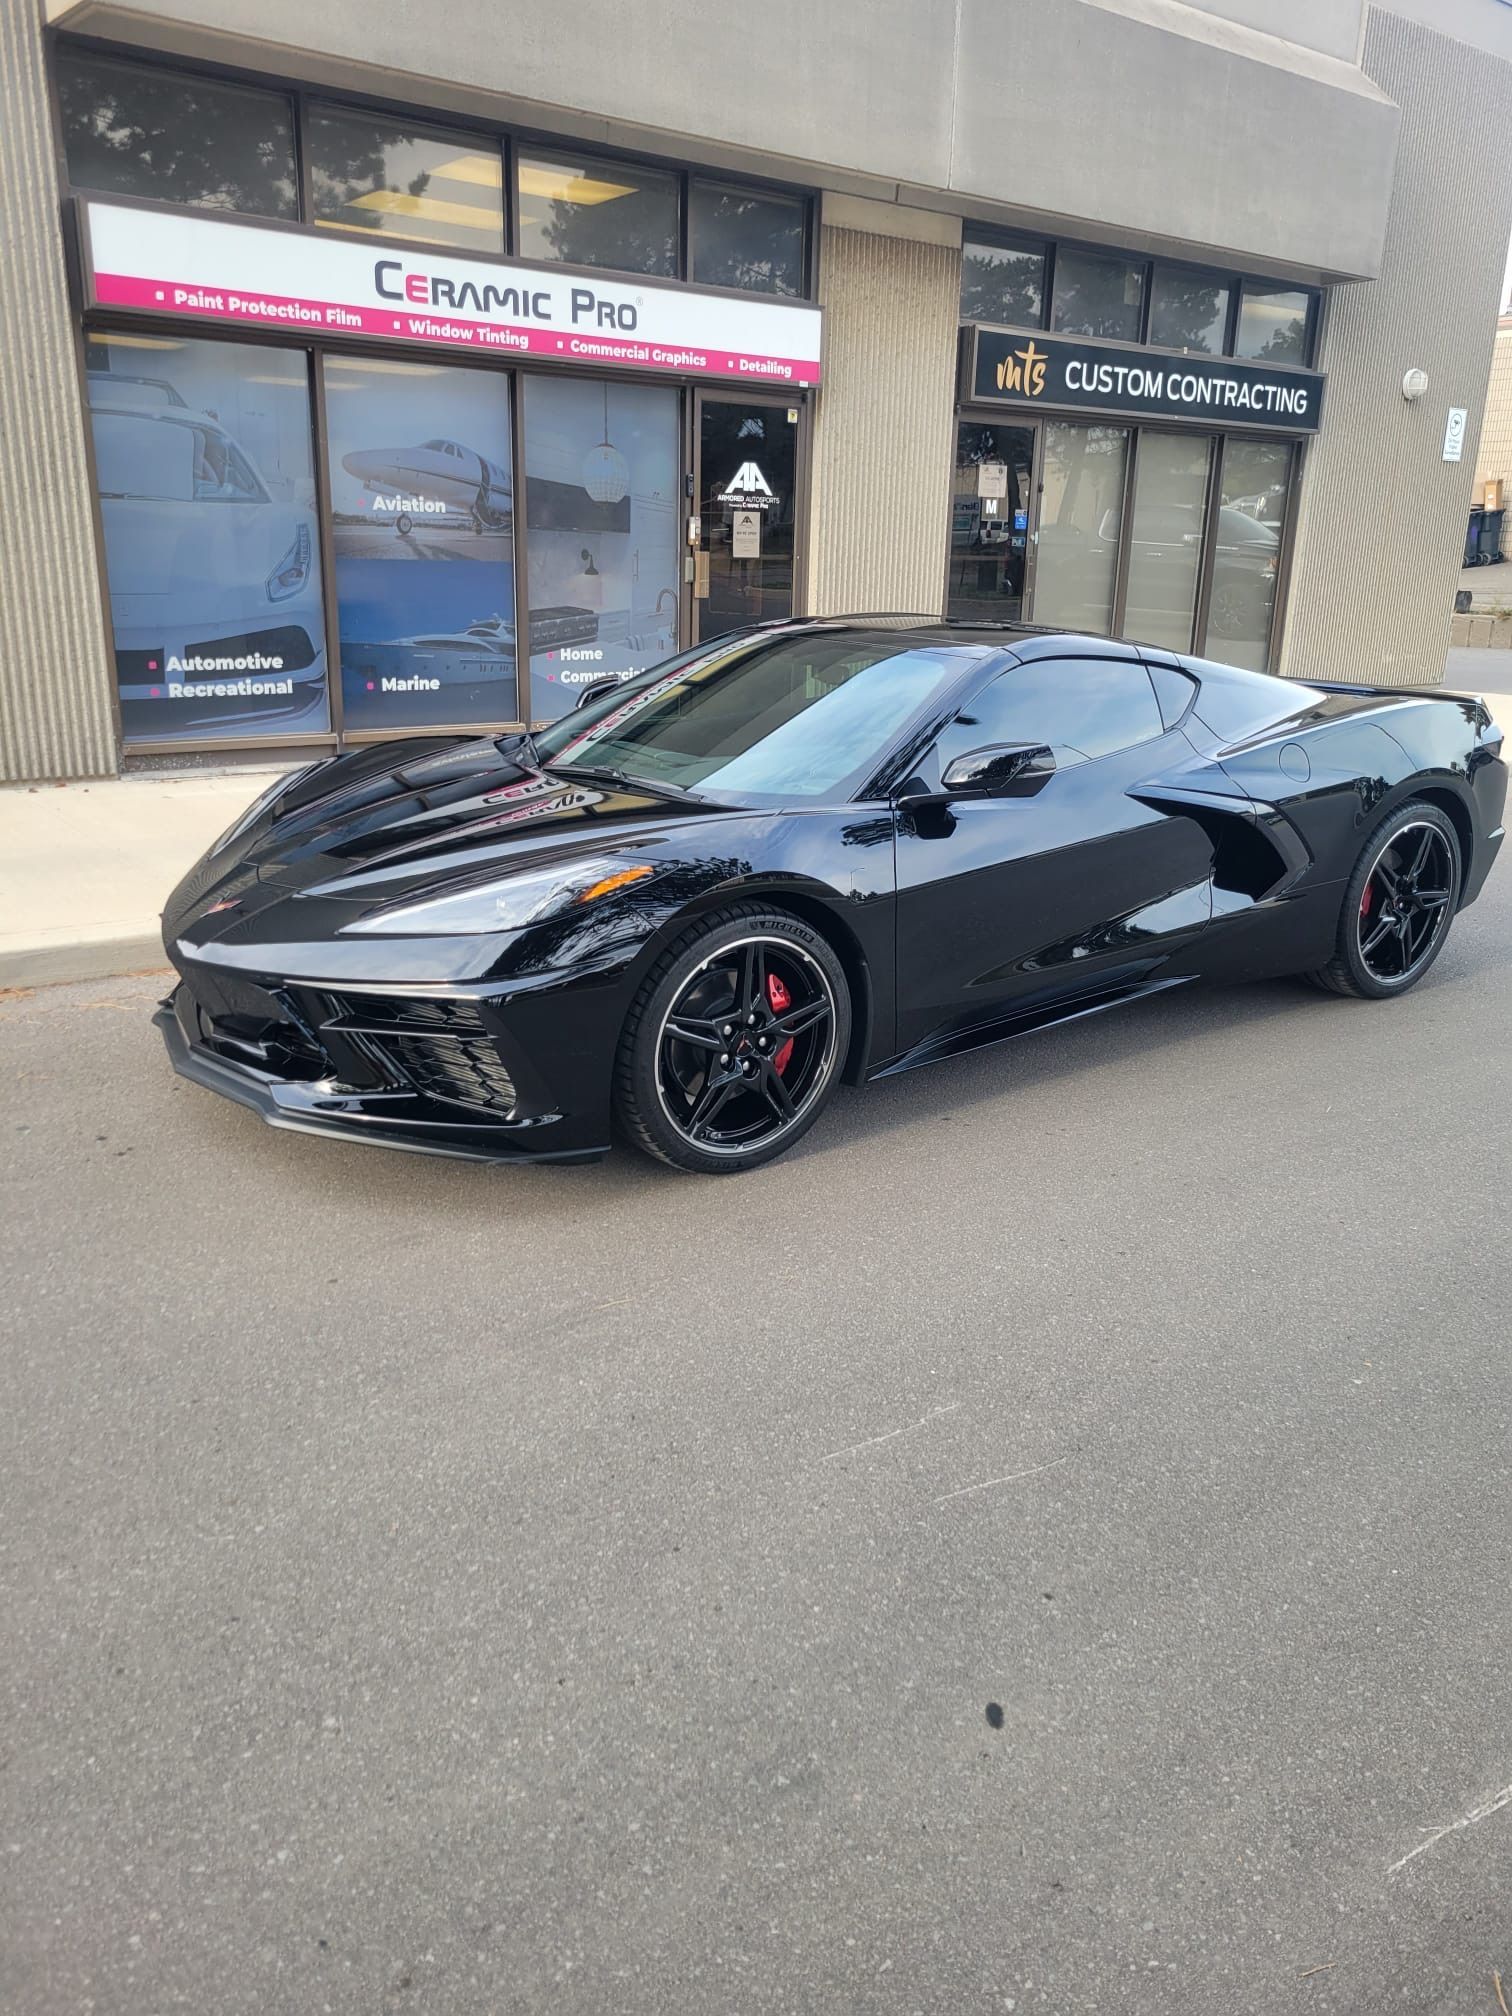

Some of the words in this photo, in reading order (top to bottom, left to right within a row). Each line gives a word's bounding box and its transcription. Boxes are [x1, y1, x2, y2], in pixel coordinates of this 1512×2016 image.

[374, 260, 552, 321] CERAMIC
[174, 289, 225, 312] Paint
[228, 298, 322, 323] Protection
[326, 308, 363, 328] Film
[408, 318, 473, 342] Window
[476, 326, 530, 350] Tinting
[570, 339, 650, 361] Commercial
[652, 351, 707, 367] Graphics
[739, 358, 792, 377] Detailing
[1065, 361, 1163, 399] CUSTOM
[1166, 375, 1307, 415] CONTRACTING
[372, 494, 447, 513] Aviation
[717, 494, 744, 502] ARMORED
[166, 652, 284, 672] Automotive
[560, 648, 604, 661] Home
[168, 678, 294, 698] Recreational
[381, 675, 440, 692] Marine
[764, 920, 815, 942] MICHELIN
